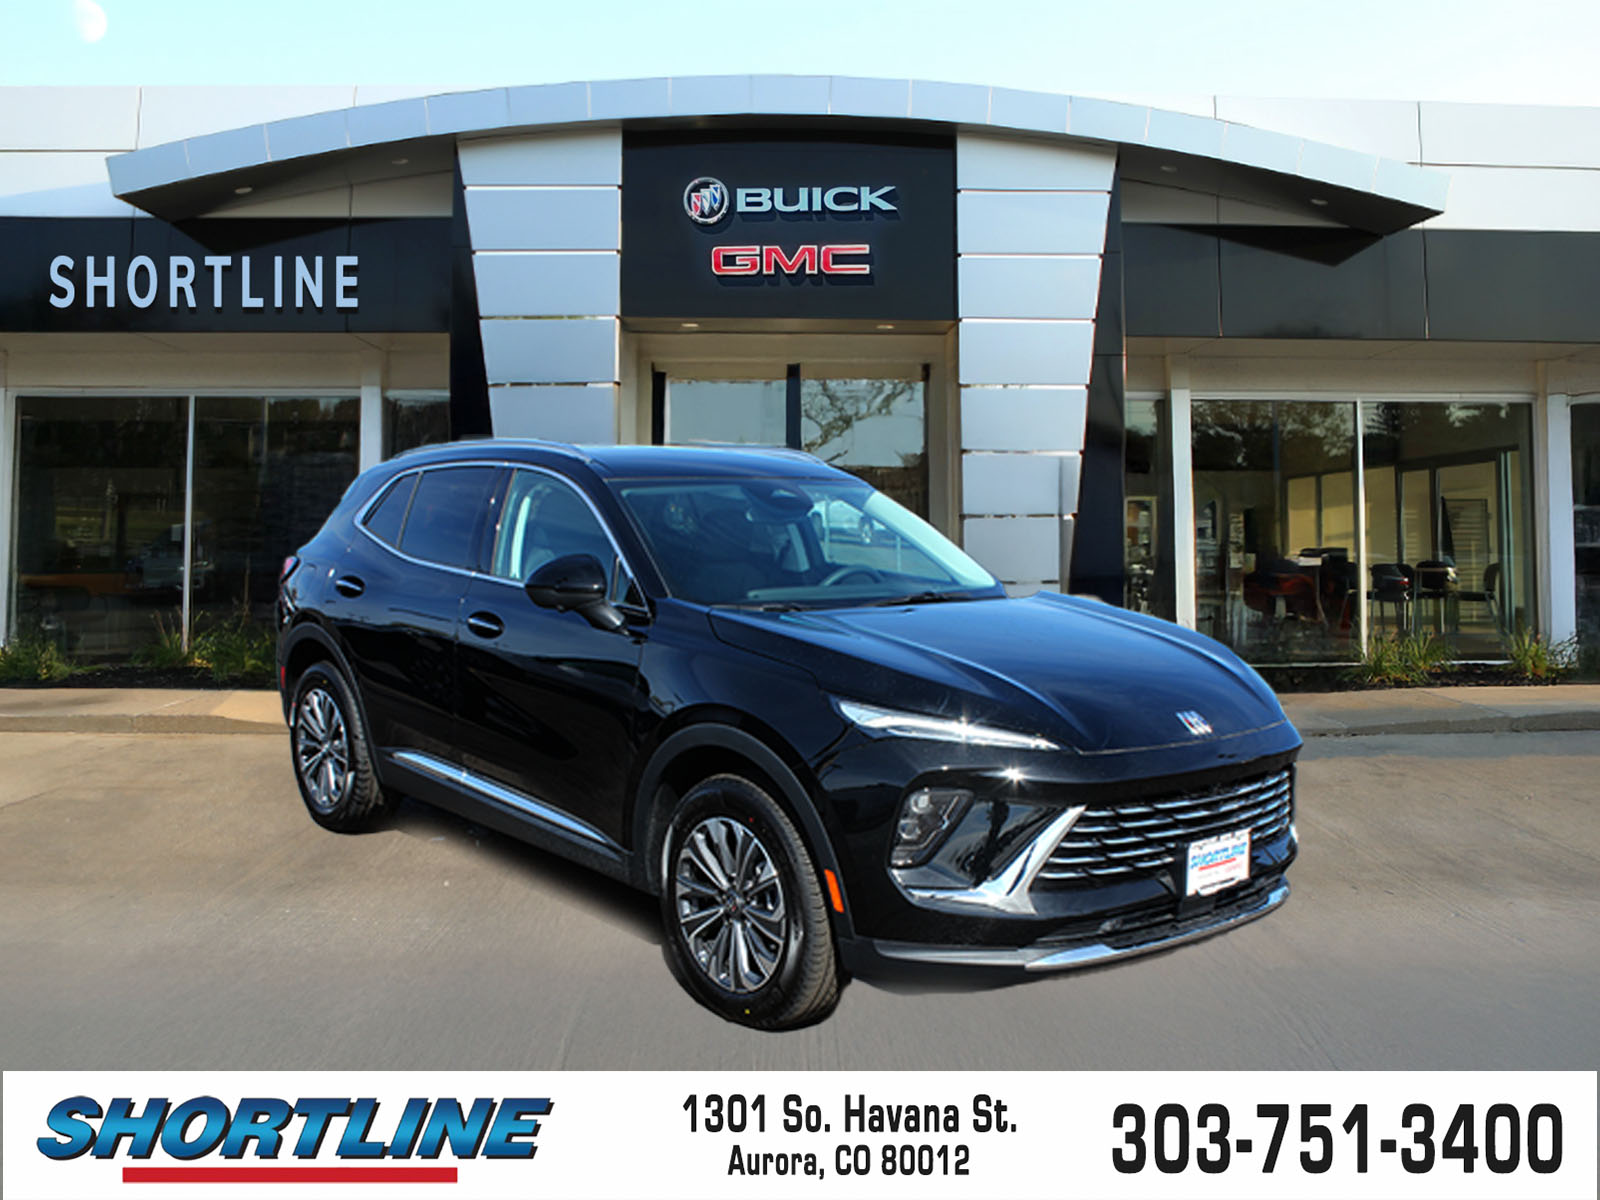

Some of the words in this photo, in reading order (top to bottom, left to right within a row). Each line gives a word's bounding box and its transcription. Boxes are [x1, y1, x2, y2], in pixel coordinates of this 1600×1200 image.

[736, 186, 898, 212] BUICK
[711, 244, 870, 275] GMC
[49, 255, 359, 308] SHORTLINE
